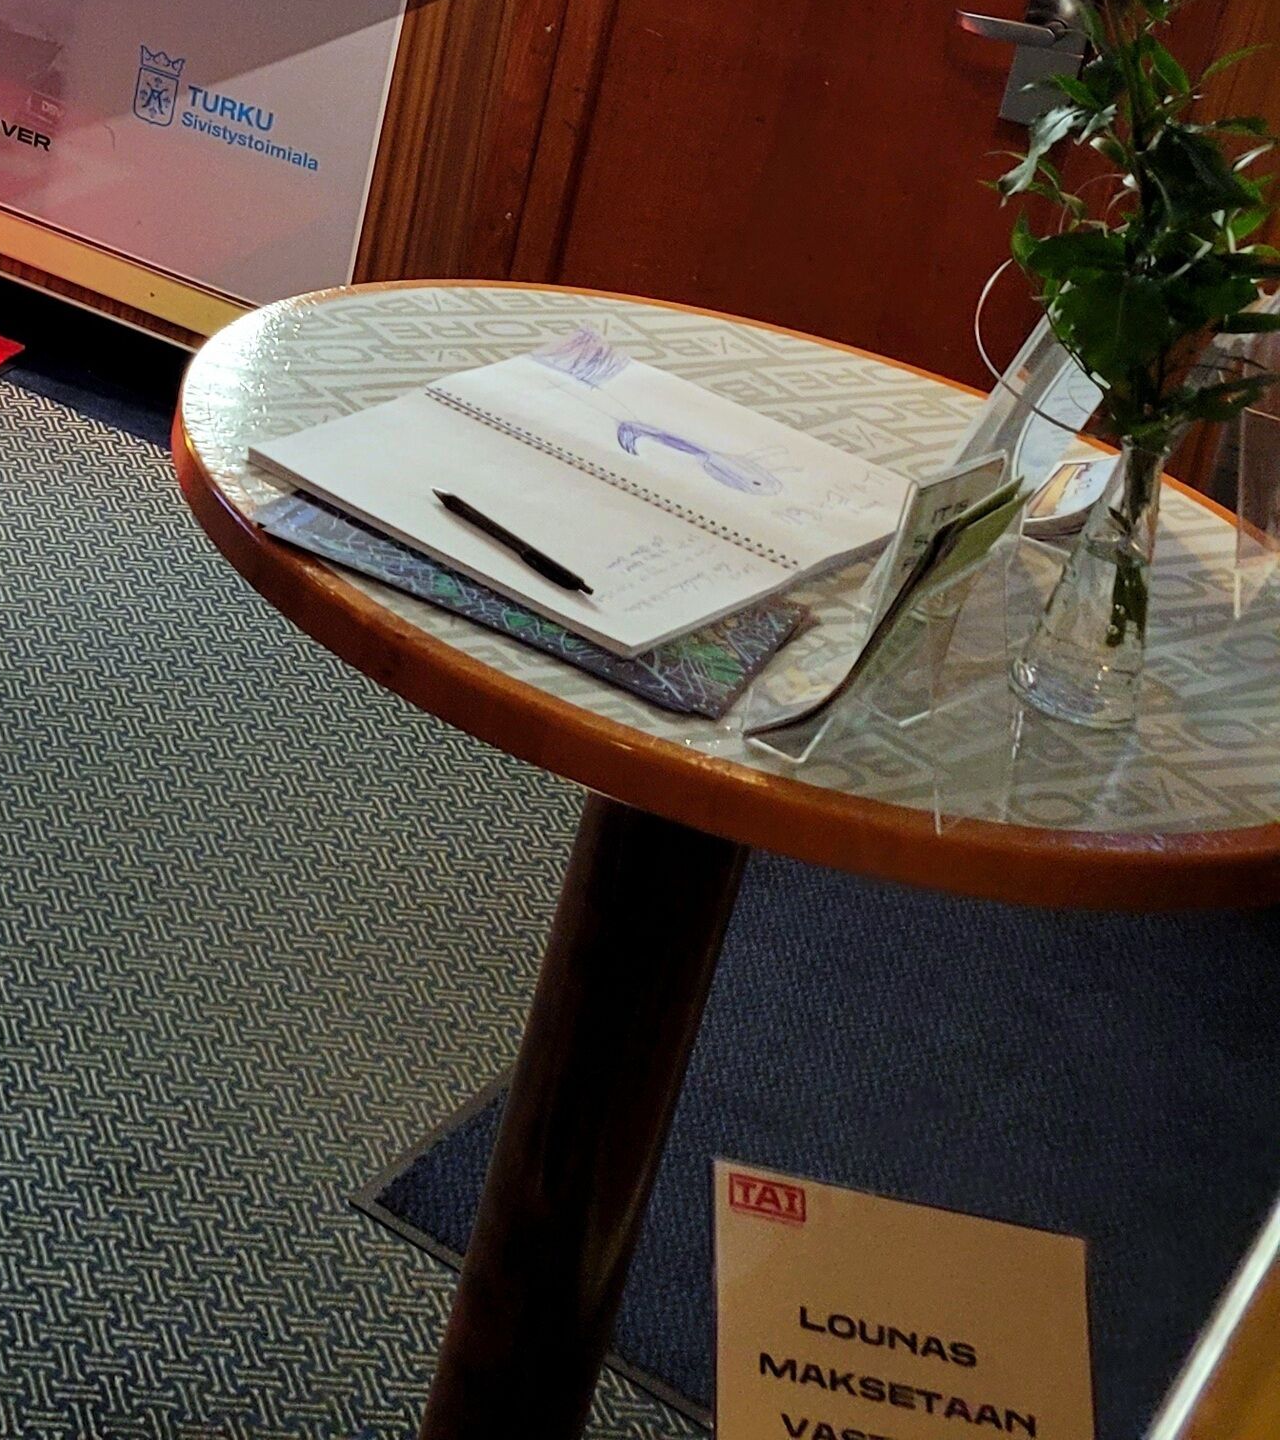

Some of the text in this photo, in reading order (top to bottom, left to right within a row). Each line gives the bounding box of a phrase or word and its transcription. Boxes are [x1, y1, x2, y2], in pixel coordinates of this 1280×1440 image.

[187, 84, 275, 133] TURKU
[181, 110, 320, 172] Sivistystoimiala
[734, 1176, 804, 1215] TAI
[798, 1305, 979, 1368] LOUNAS
[758, 1351, 1038, 1439] MAKSETAAN
